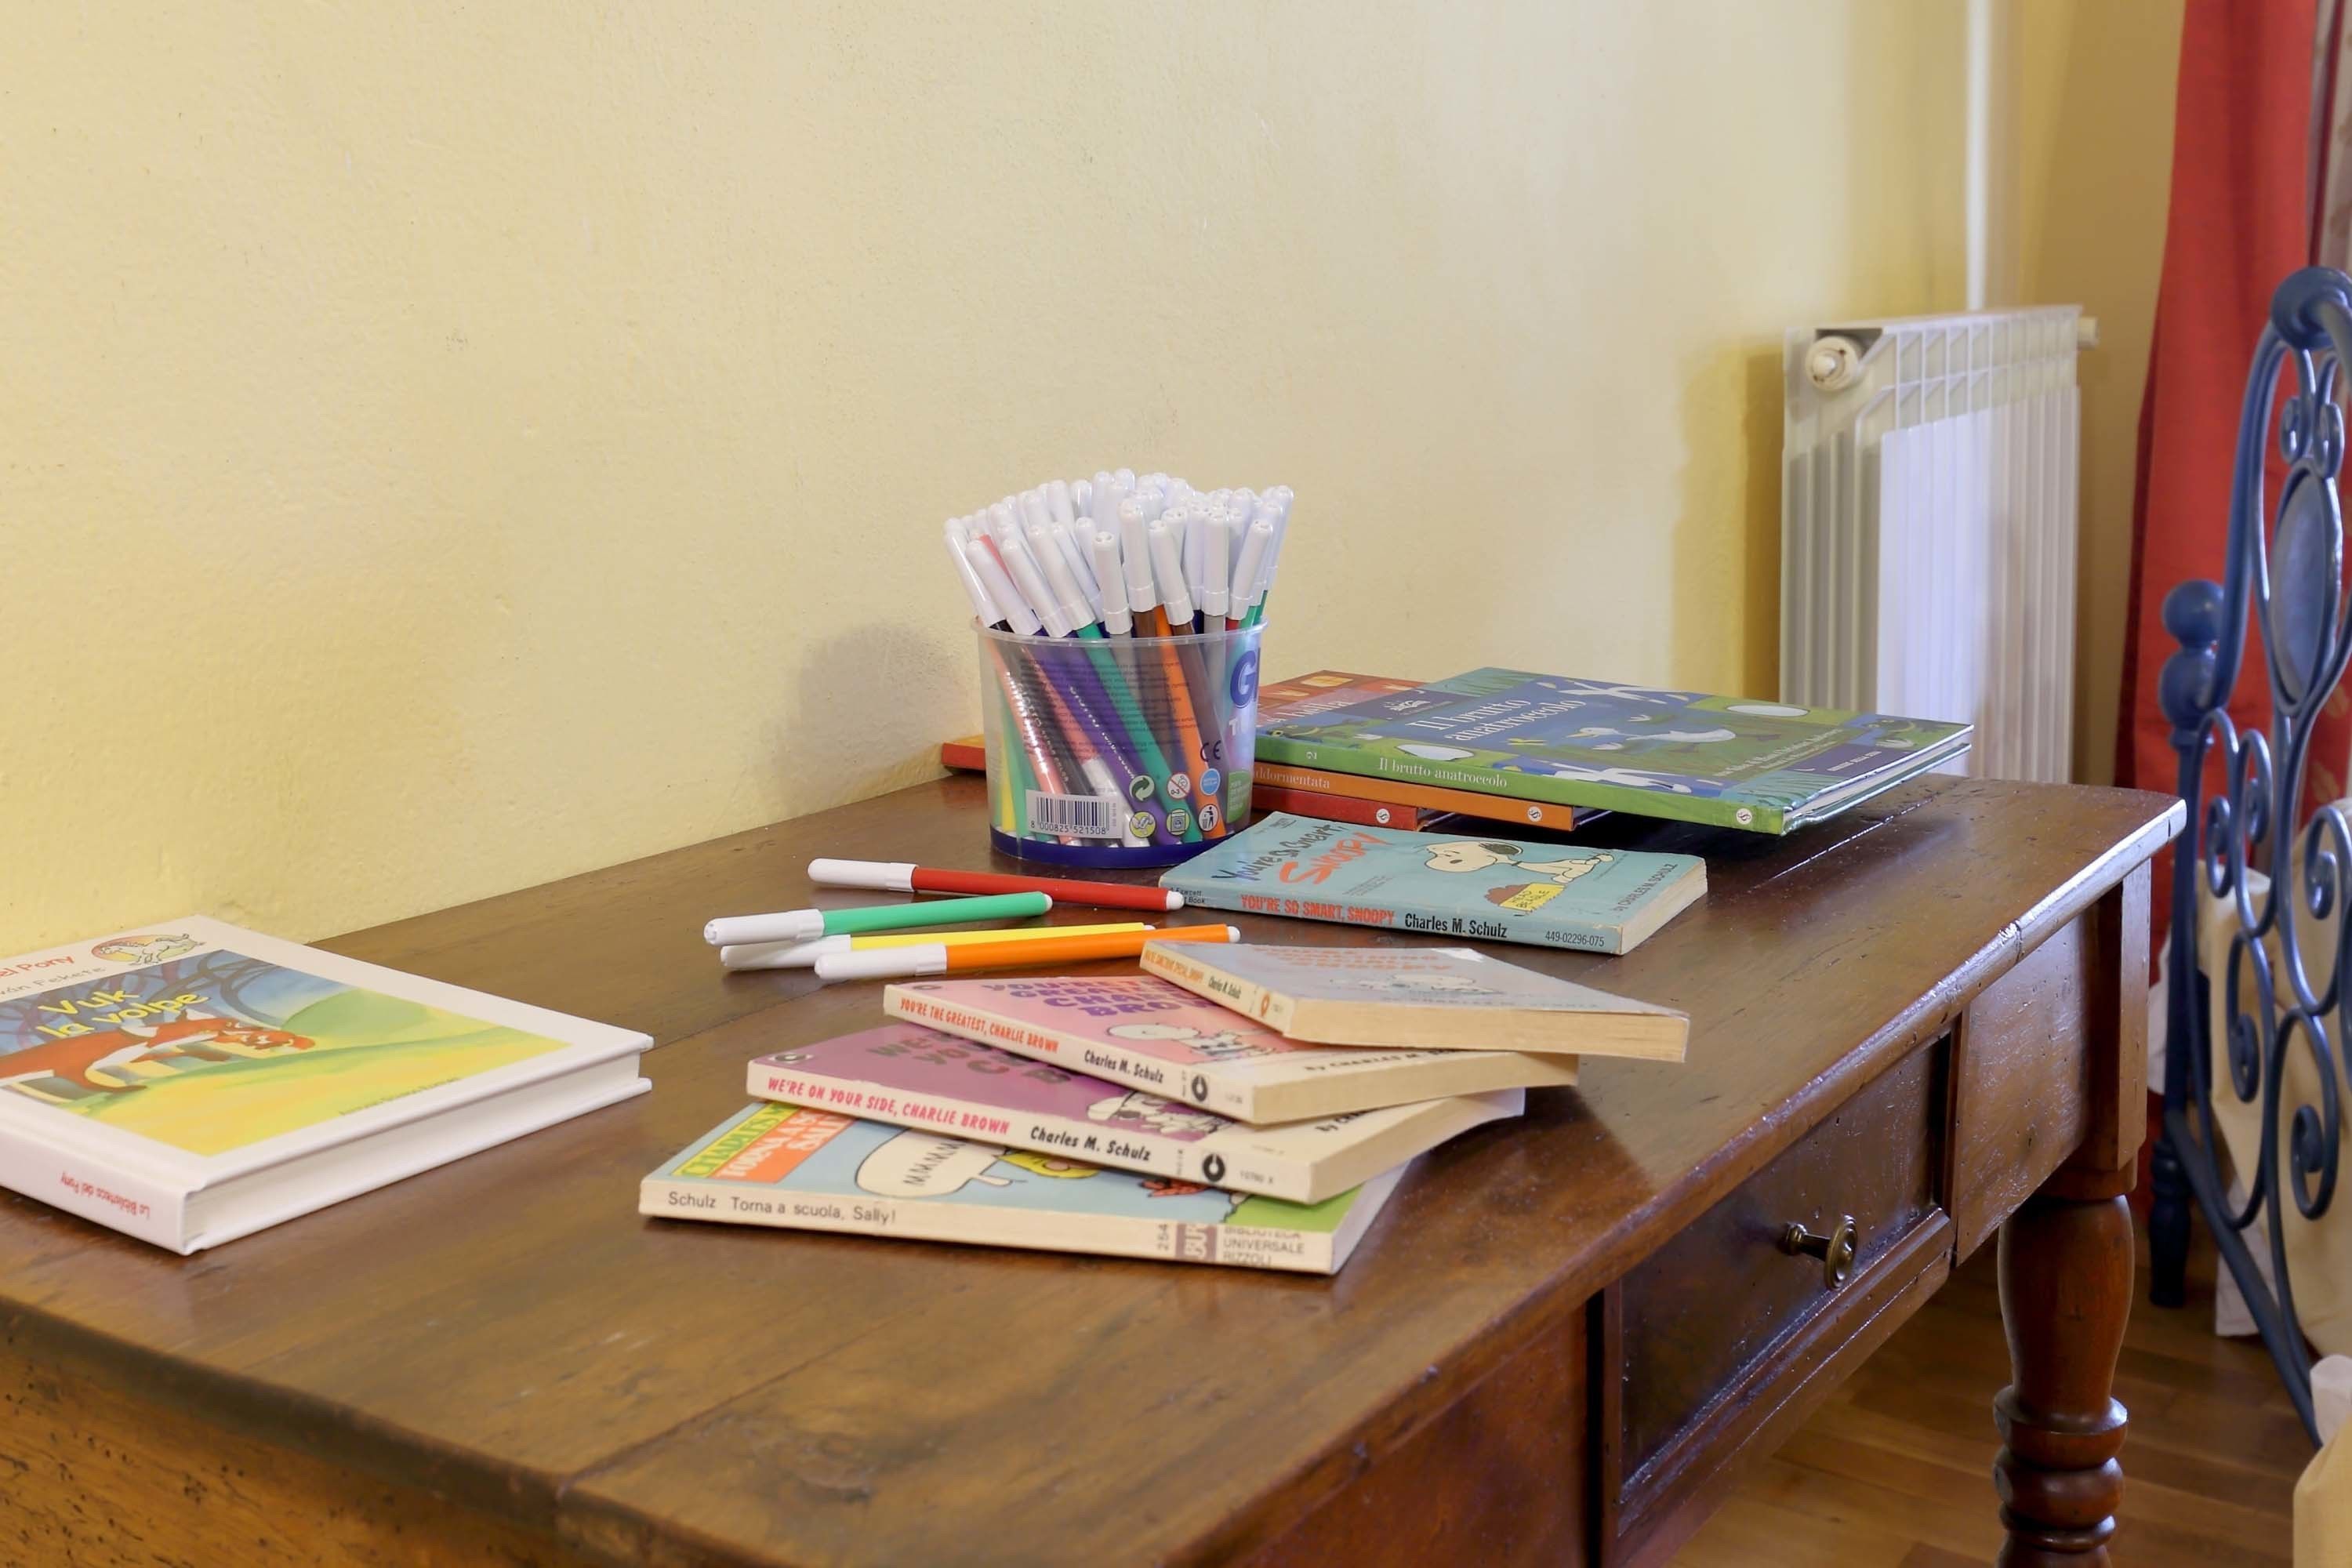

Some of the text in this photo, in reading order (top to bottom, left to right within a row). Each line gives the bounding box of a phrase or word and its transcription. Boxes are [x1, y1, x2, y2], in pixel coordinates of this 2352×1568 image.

[1405, 720, 1457, 731] Il
[1432, 699, 1530, 723] brutto
[1444, 700, 1587, 741] anatroccolo
[1305, 751, 1318, 760] 2
[1255, 765, 1331, 789] ddormentata
[1379, 757, 1508, 788] Il brutto anatroccolo
[1030, 820, 1107, 835] 8 000825 521508
[1241, 894, 1606, 947] YOU'RE SO SMART, SNOOPY Charles M. Schulz 449-02296-075
[16, 956, 75, 972] Pony
[36, 993, 210, 1039] la volpe
[37, 990, 141, 1014] Vuk
[901, 997, 927, 1017] YOU'RE
[930, 1005, 944, 1022] THE
[946, 1010, 988, 1036] GREATEST,
[989, 1023, 1025, 1043] CHARLIE
[1027, 1032, 1059, 1054] BROWN
[1084, 1049, 1117, 1071] Charles
[1120, 1059, 1131, 1074] M.
[1134, 1063, 1164, 1084] Schulz
[768, 1076, 804, 1097] WE'RE
[808, 1085, 826, 1099] ON
[829, 1087, 863, 1109] YOUR
[866, 1095, 898, 1117] SIDE,
[902, 1102, 957, 1126] CHARLIE
[961, 1112, 1011, 1134] BROWN
[1030, 1125, 1080, 1149] Charles
[1083, 1135, 1101, 1152] M.
[1106, 1139, 1152, 1163] Schulz
[668, 1191, 717, 1209] Schulz
[731, 1196, 773, 1214] Torna
[777, 1203, 786, 1214] a
[853, 1206, 897, 1225] Sally!
[1223, 1237, 1305, 1255] UNIVERSALE
